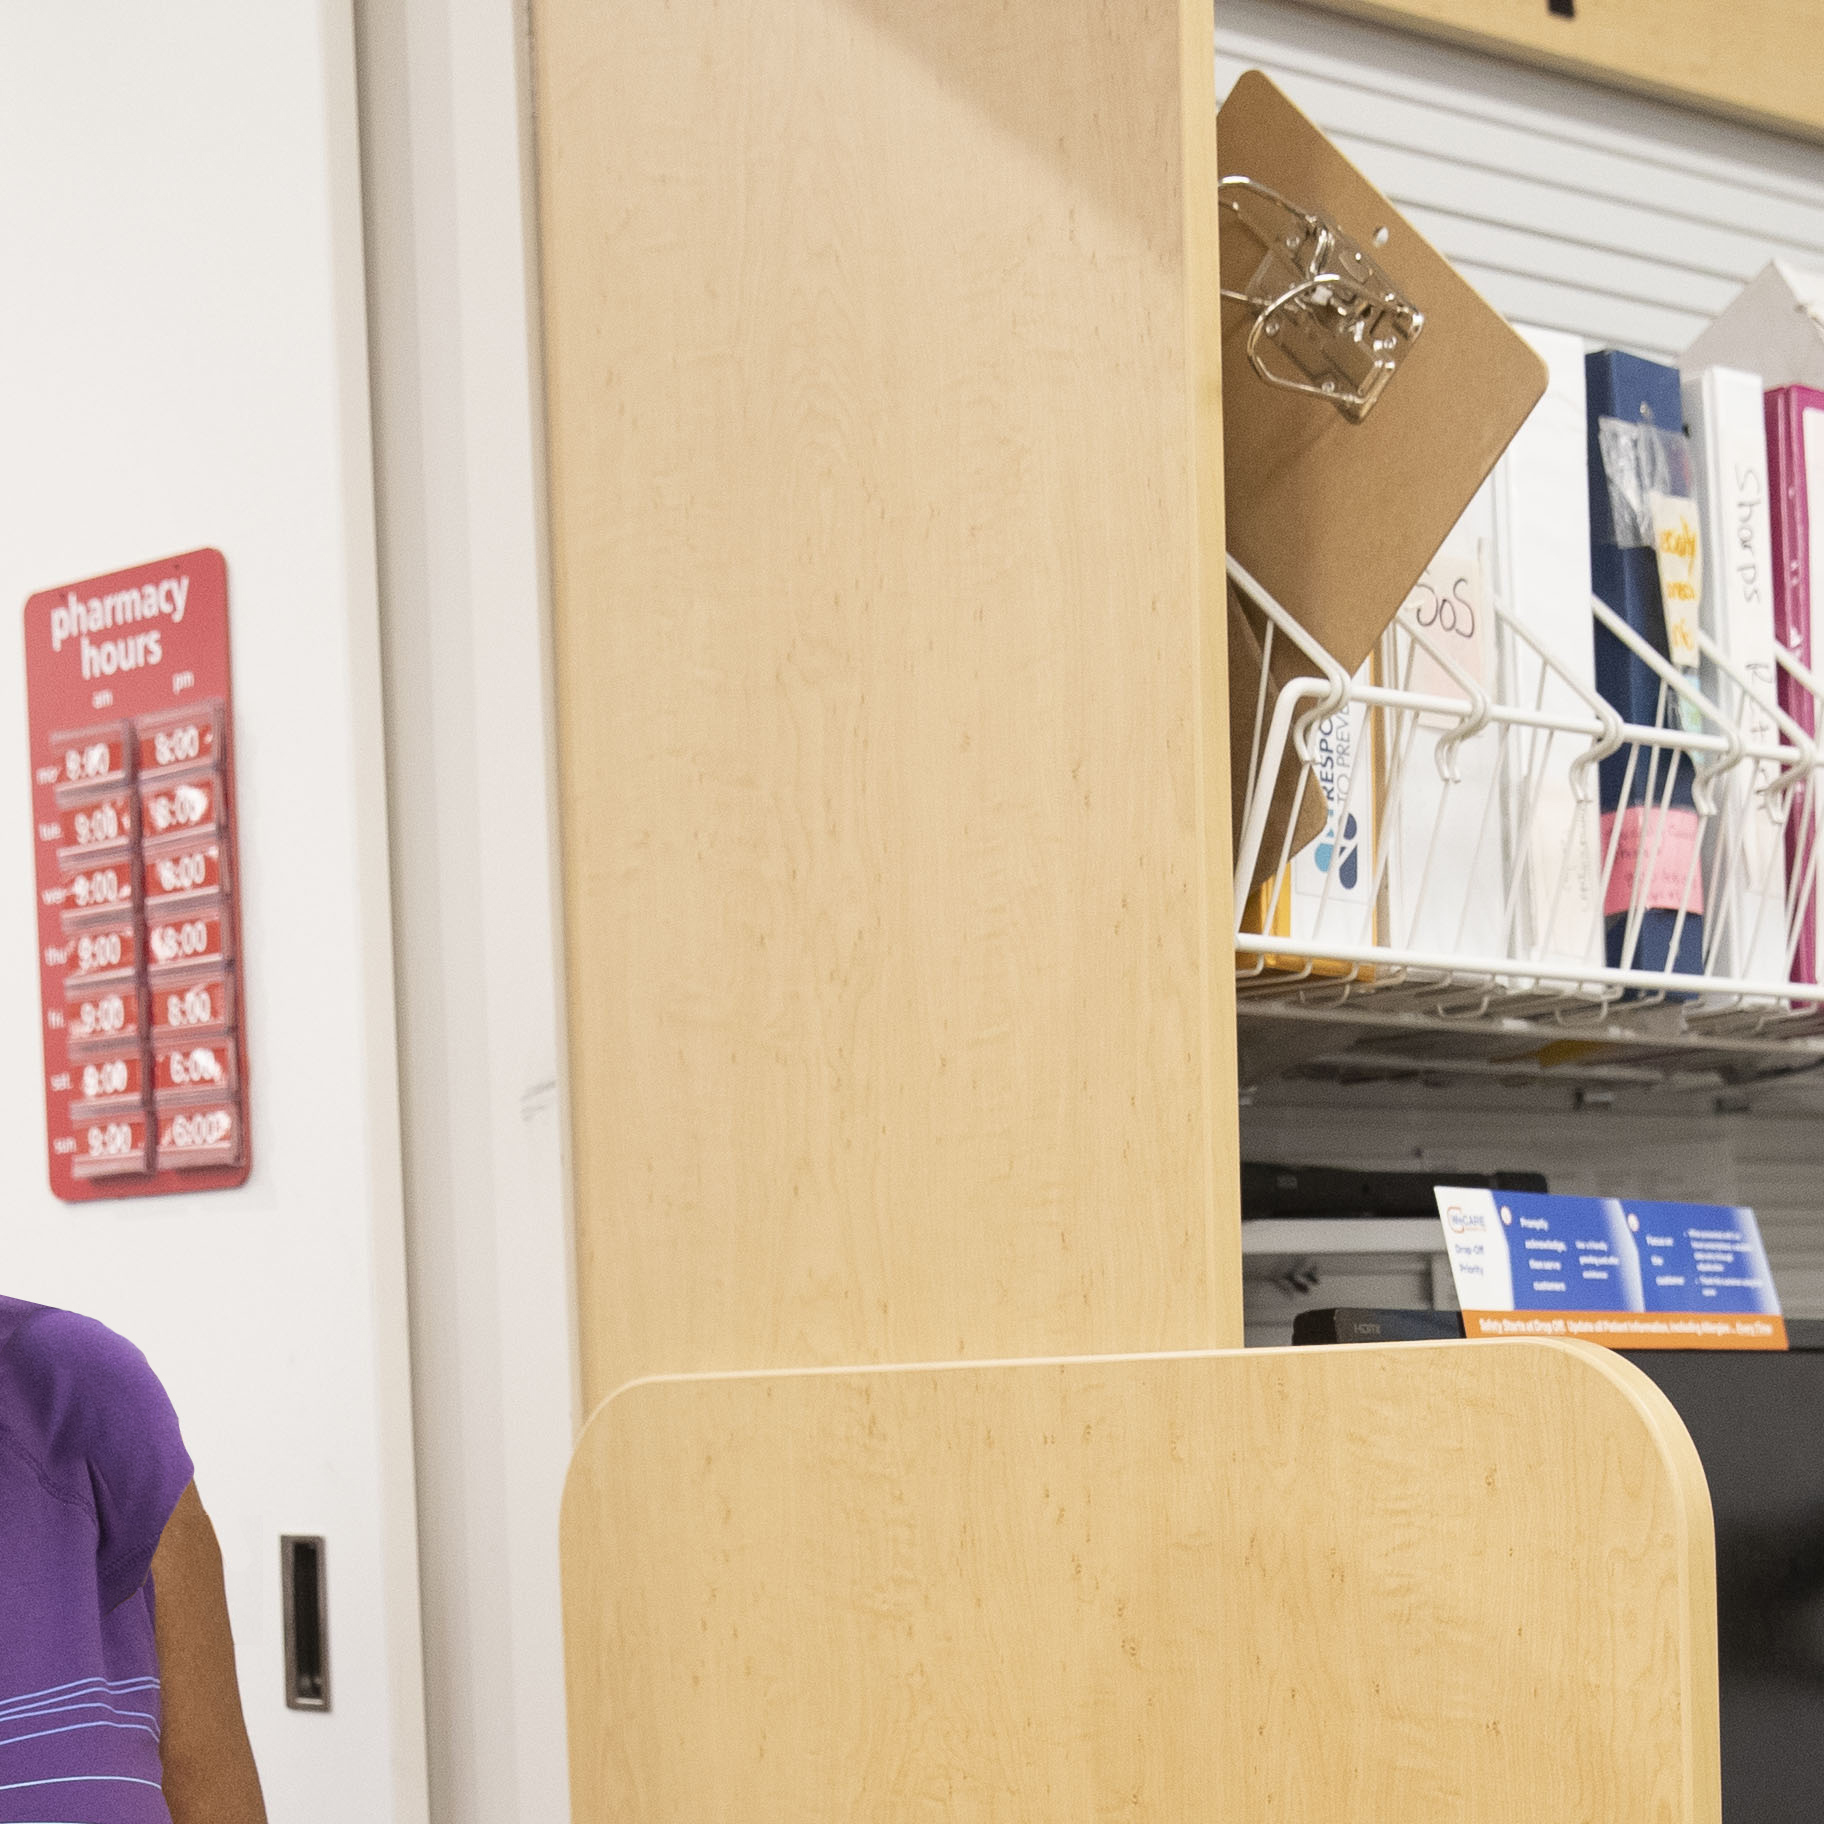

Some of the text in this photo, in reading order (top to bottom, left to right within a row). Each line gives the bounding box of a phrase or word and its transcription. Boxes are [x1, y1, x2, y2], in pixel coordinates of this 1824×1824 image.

[1735, 463, 1762, 604] Sharps
[50, 575, 189, 652] pharmacy
[79, 629, 163, 680] hours
[92, 670, 195, 710] am pm
[154, 725, 200, 765] 8:00
[1336, 774, 1353, 804] TO
[77, 933, 121, 970] 9:00
[80, 995, 124, 1034] 9:00
[167, 991, 212, 1026] 8:00
